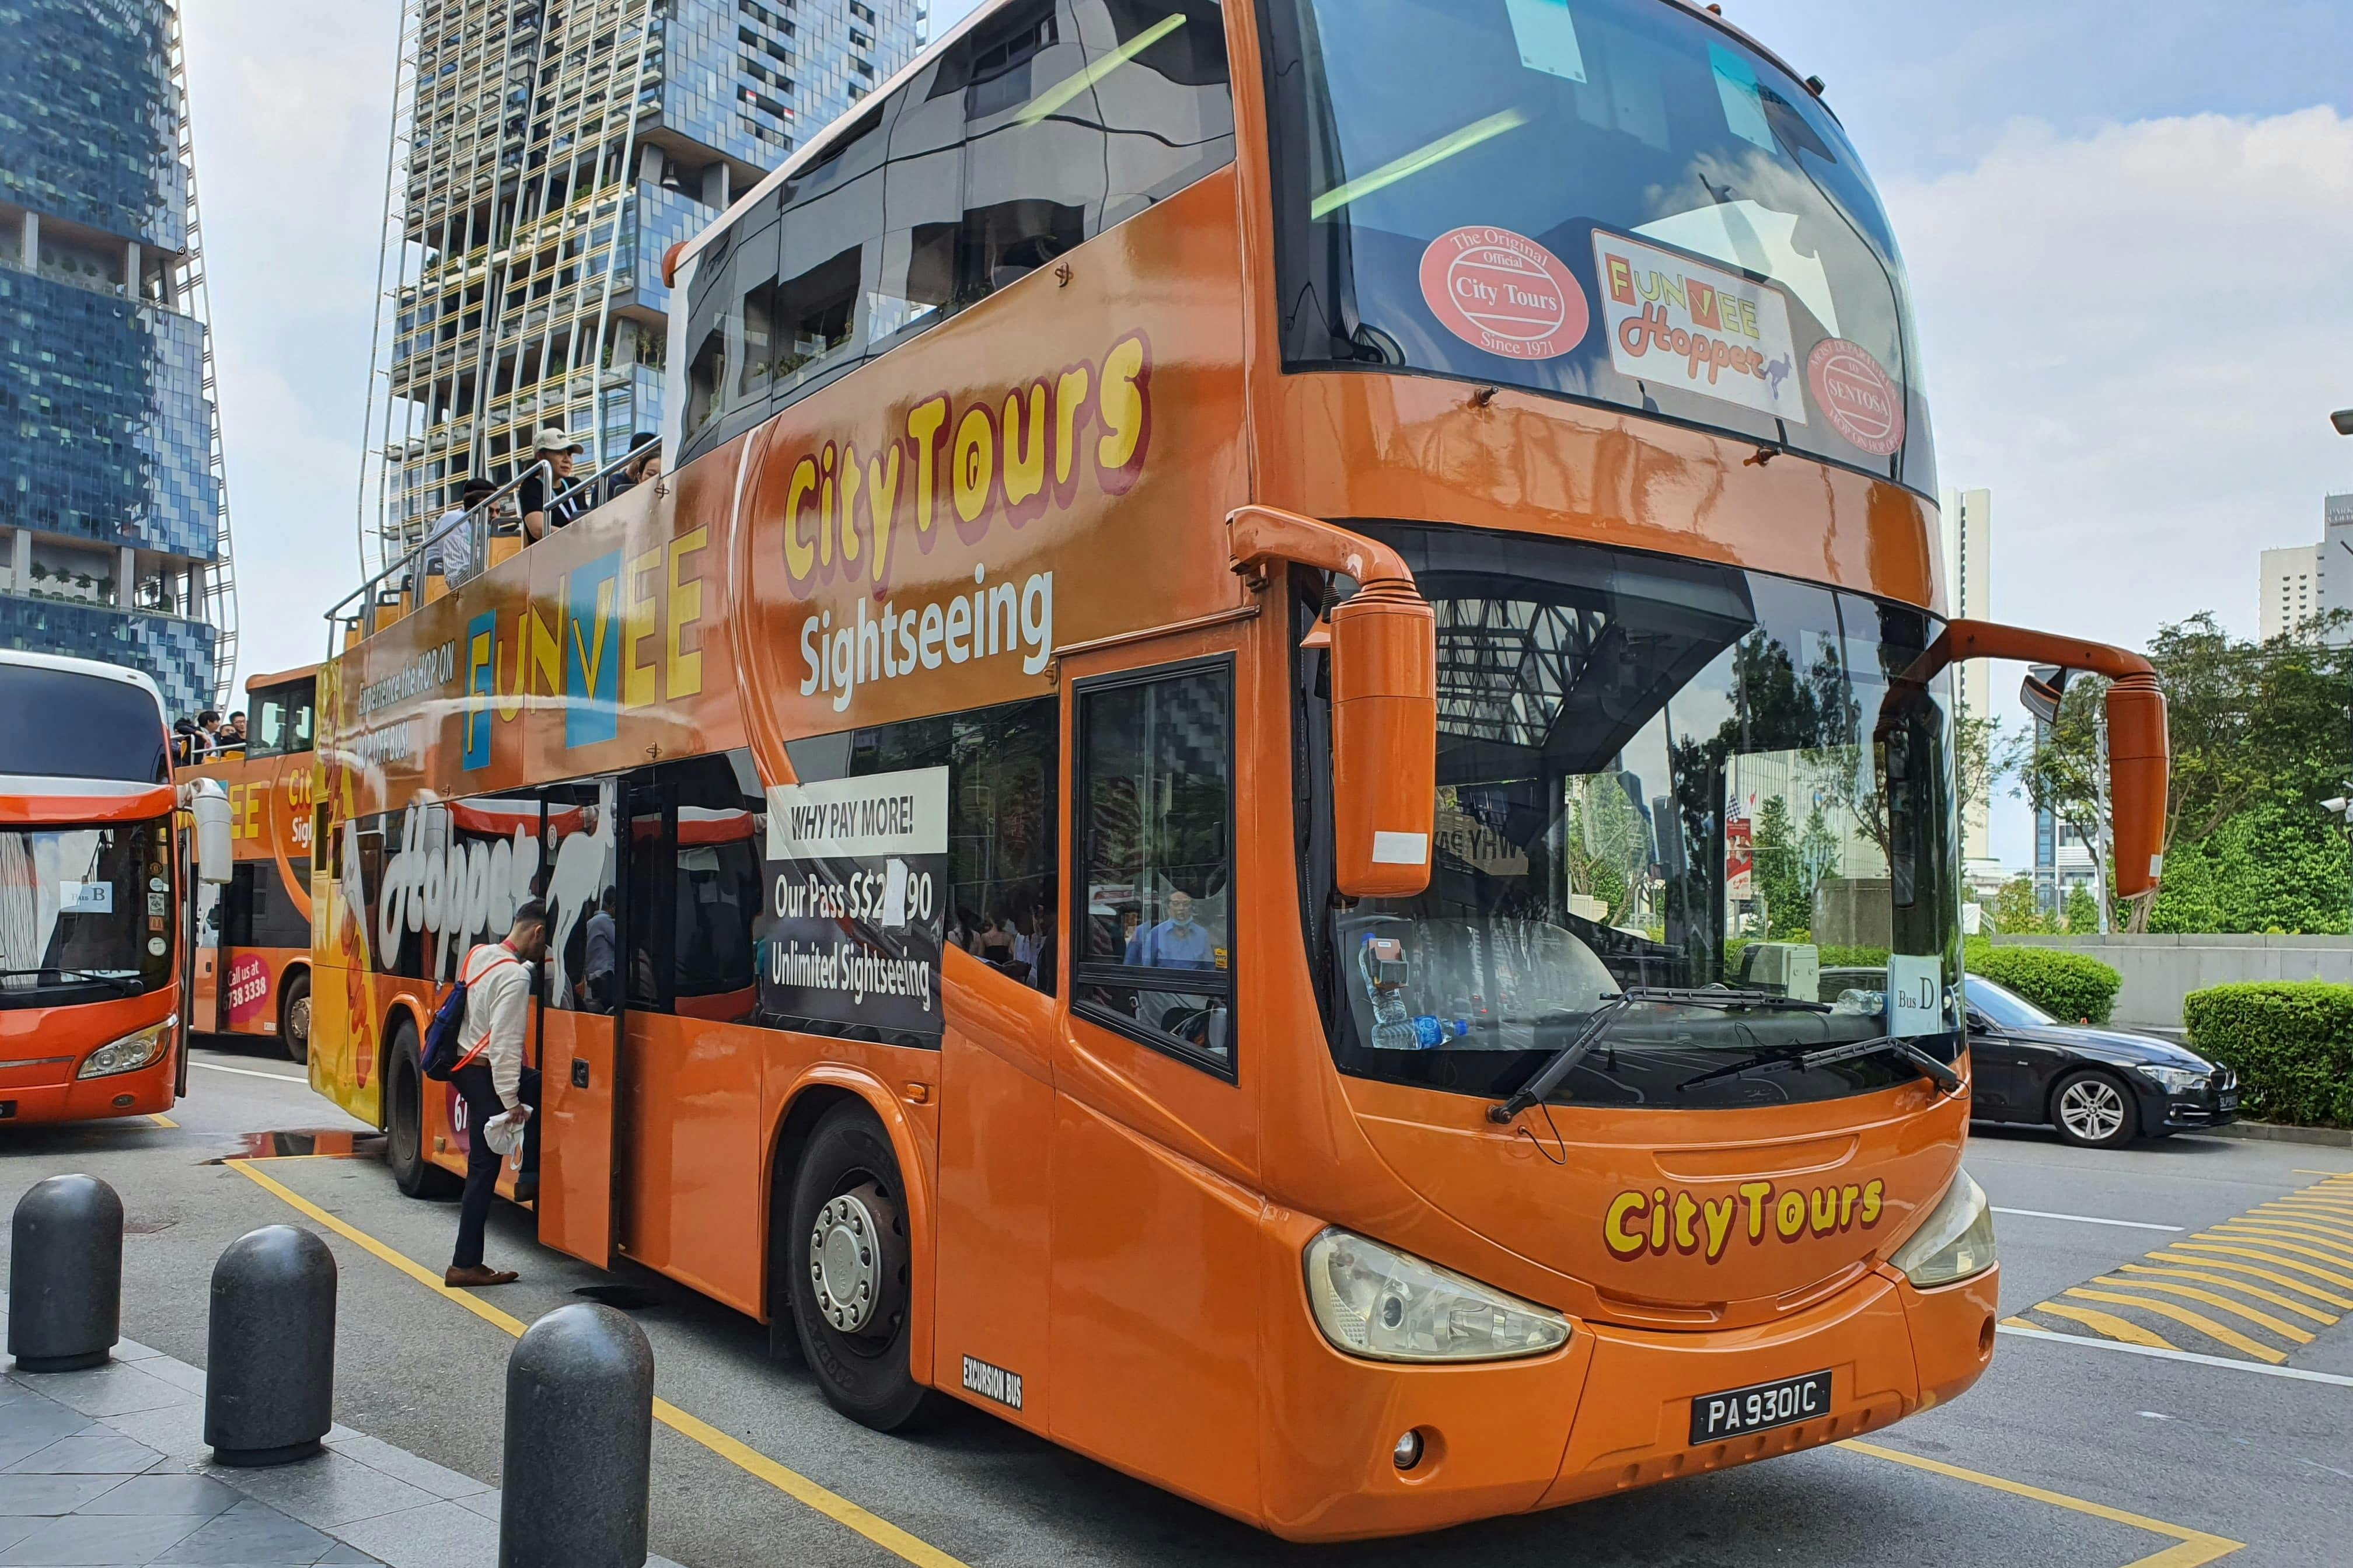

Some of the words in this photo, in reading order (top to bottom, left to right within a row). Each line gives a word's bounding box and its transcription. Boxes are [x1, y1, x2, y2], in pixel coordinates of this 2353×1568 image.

[1450, 231, 1481, 251] The
[1484, 229, 1548, 267] Original
[1483, 252, 1523, 268] Official
[1456, 276, 1497, 306] City
[1503, 284, 1558, 311] Tours
[1609, 259, 1760, 340] FUNVEE
[1480, 331, 1521, 354] Since
[1526, 340, 1555, 355] 1971
[1618, 301, 1767, 385] Hopper
[1828, 378, 1889, 417] SENTOSA
[1830, 409, 1851, 434] HOP
[1853, 432, 1867, 448] ON
[1869, 439, 1885, 453] HOP
[465, 524, 708, 757] FUNVEE
[800, 563, 1053, 712] Sightseeing
[358, 673, 400, 718] Experience
[402, 660, 416, 699] the
[417, 648, 437, 692] HOP
[439, 640, 455, 685] ON
[356, 734, 372, 770] HOP
[373, 728, 389, 766] OFF
[389, 721, 409, 762] BUS!
[791, 804, 827, 840] WHY
[830, 800, 858, 839] PAY
[861, 795, 914, 836] MORE!
[92, 887, 106, 901] B
[775, 874, 805, 918] Our
[809, 874, 845, 919] Pass
[849, 869, 933, 924] S$290
[228, 966, 240, 987] Call
[242, 966, 250, 980] us
[251, 960, 259, 976] at
[244, 976, 266, 1002] 3338
[772, 940, 837, 990] Unlimited
[841, 943, 931, 1011] Sightseeing
[1898, 990, 1916, 1008] Bus
[1919, 976, 1934, 1010] D
[963, 1356, 1004, 1401] EXCURSION
[1006, 1372, 1021, 1408] BUS
